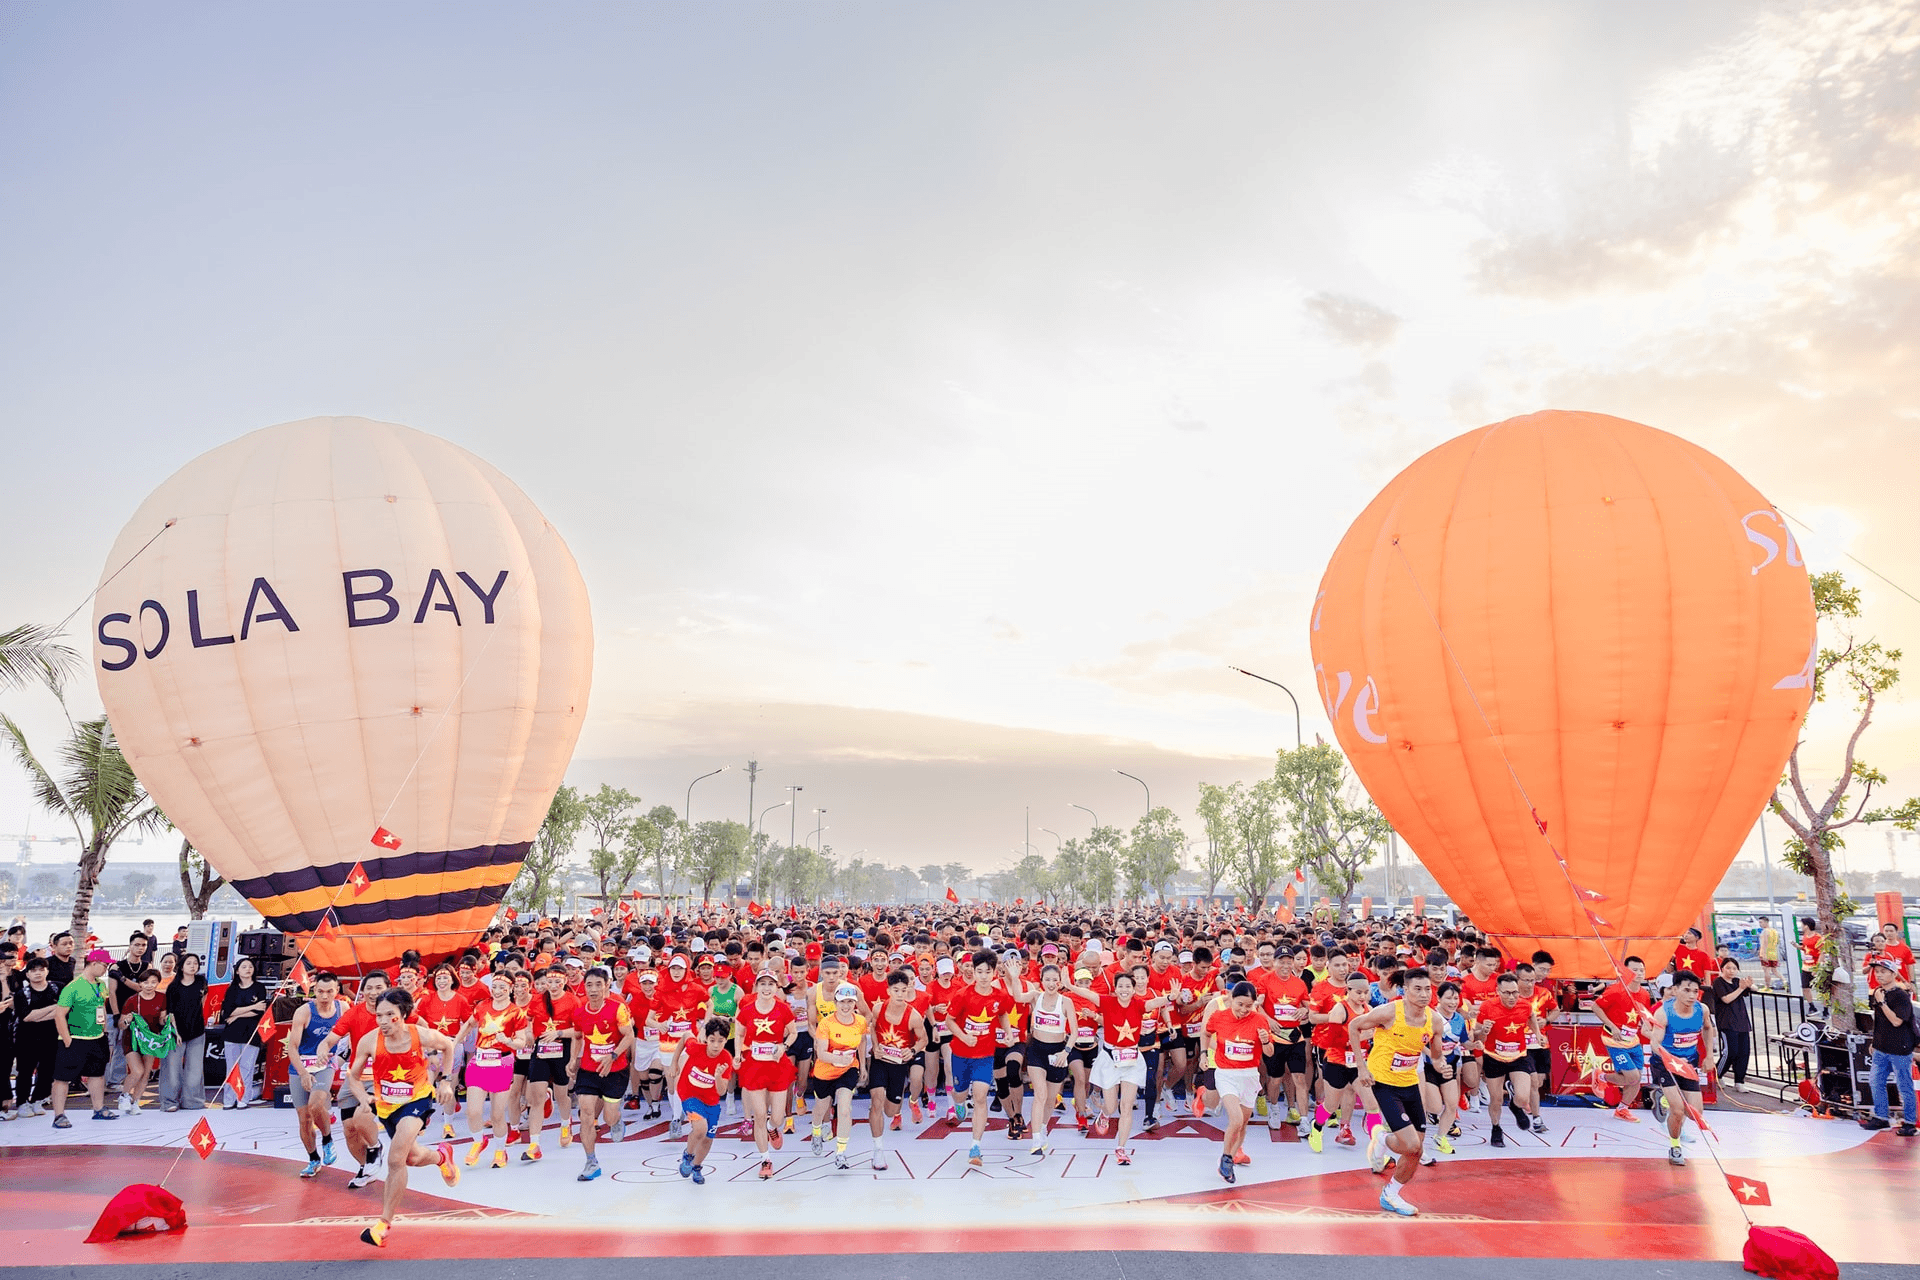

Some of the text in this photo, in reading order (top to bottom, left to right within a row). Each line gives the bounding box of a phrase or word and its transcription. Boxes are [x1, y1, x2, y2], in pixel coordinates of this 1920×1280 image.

[98, 568, 509, 672] SOLA BAY
[611, 1148, 1136, 1184] START
